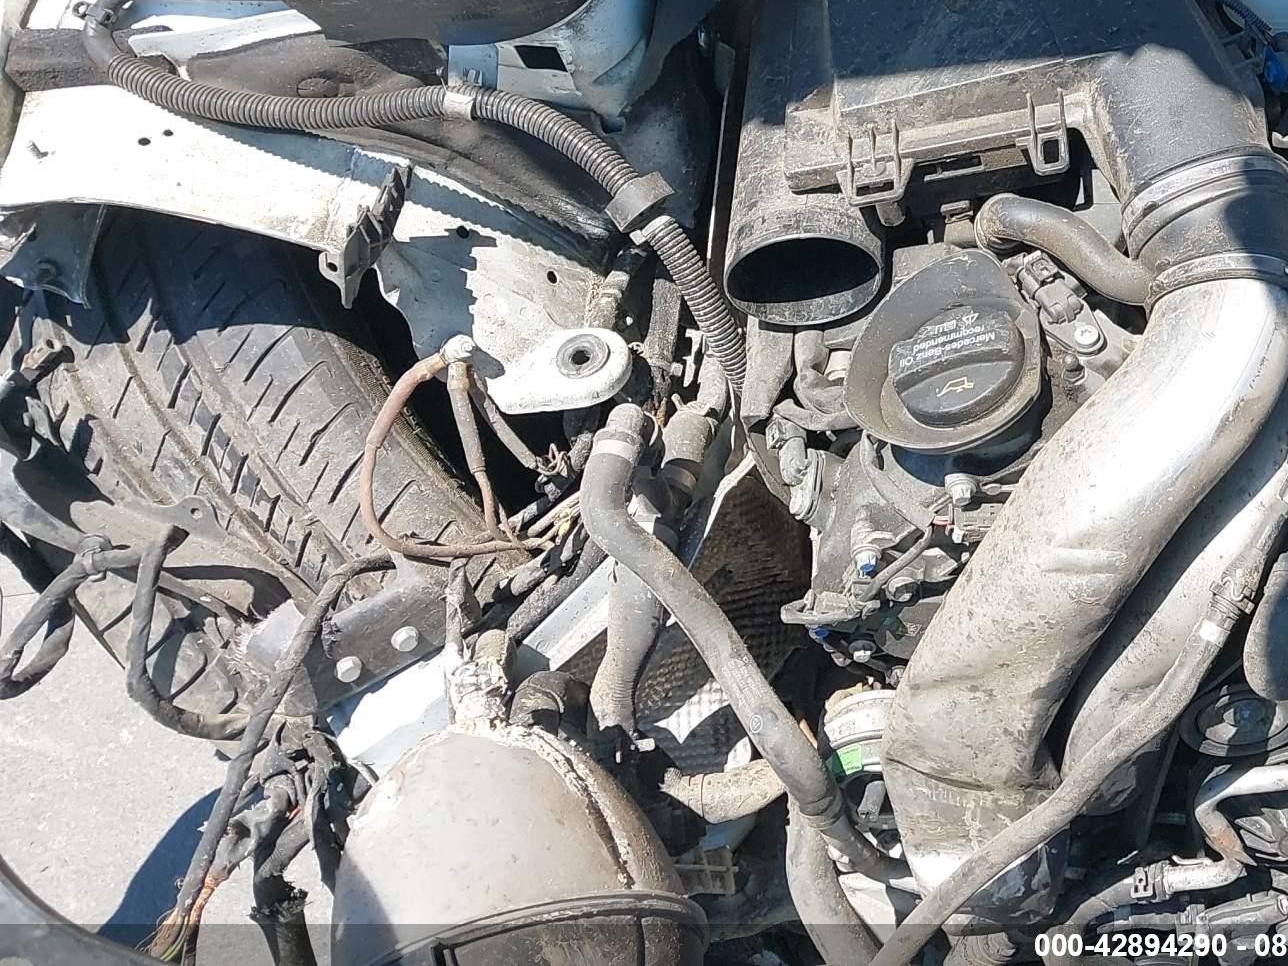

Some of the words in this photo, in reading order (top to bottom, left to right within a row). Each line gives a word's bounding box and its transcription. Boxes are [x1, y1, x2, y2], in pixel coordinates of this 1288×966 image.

[912, 324, 985, 355] recommended
[916, 331, 996, 360] Mercedes-Benz
[899, 356, 914, 368] Oil
